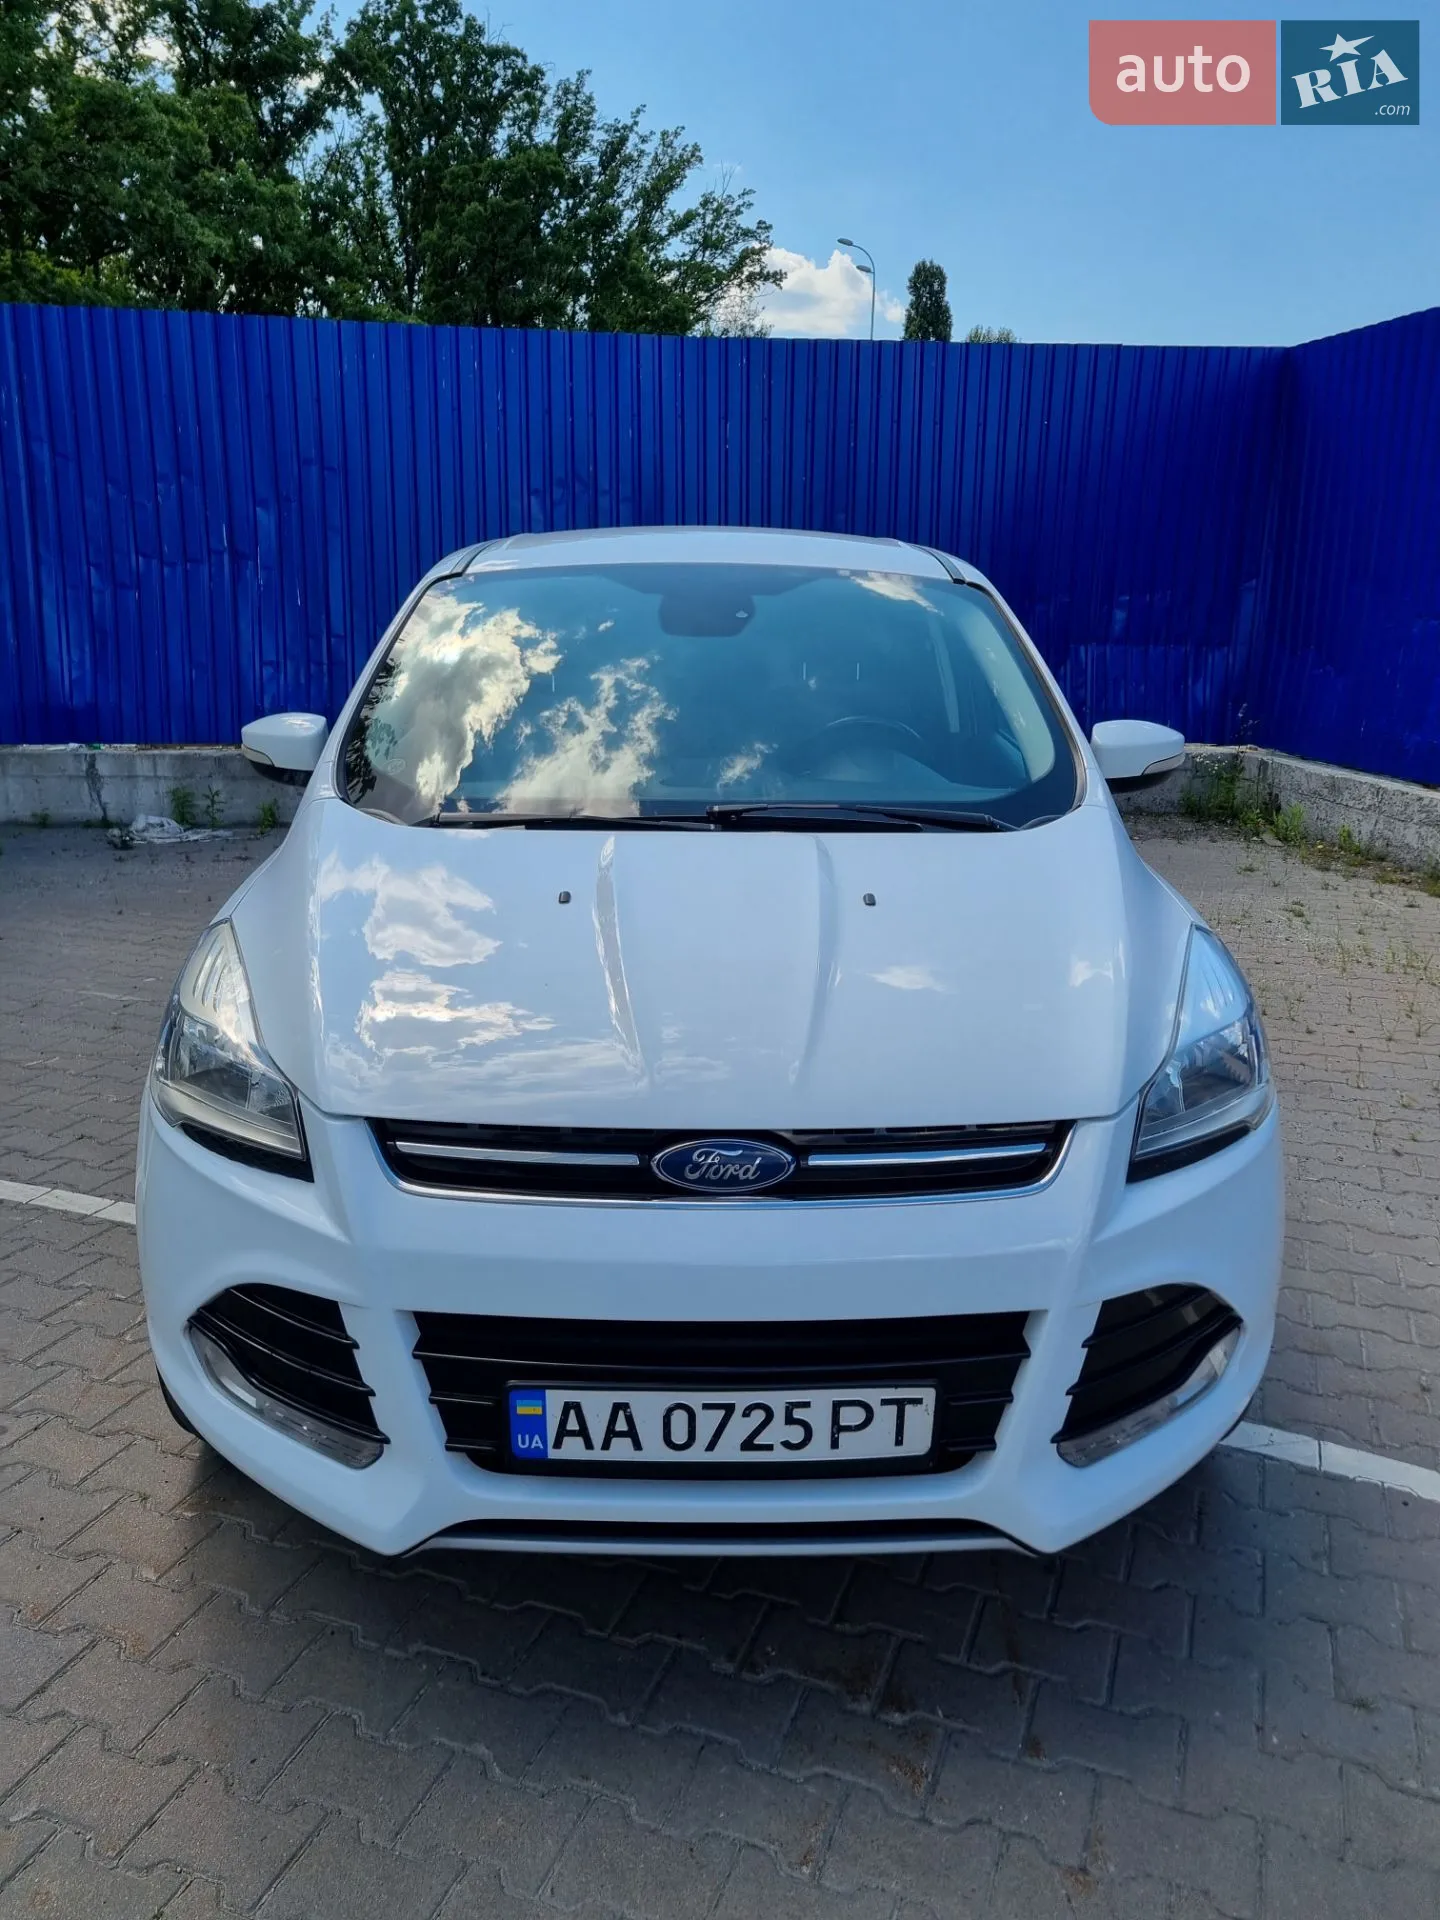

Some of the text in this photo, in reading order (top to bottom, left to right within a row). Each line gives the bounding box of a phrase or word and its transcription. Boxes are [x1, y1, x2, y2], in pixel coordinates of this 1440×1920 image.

[684, 1148, 763, 1180] Ford
[551, 1397, 924, 1453] AA 0725 PT
[517, 1433, 544, 1450] UA
